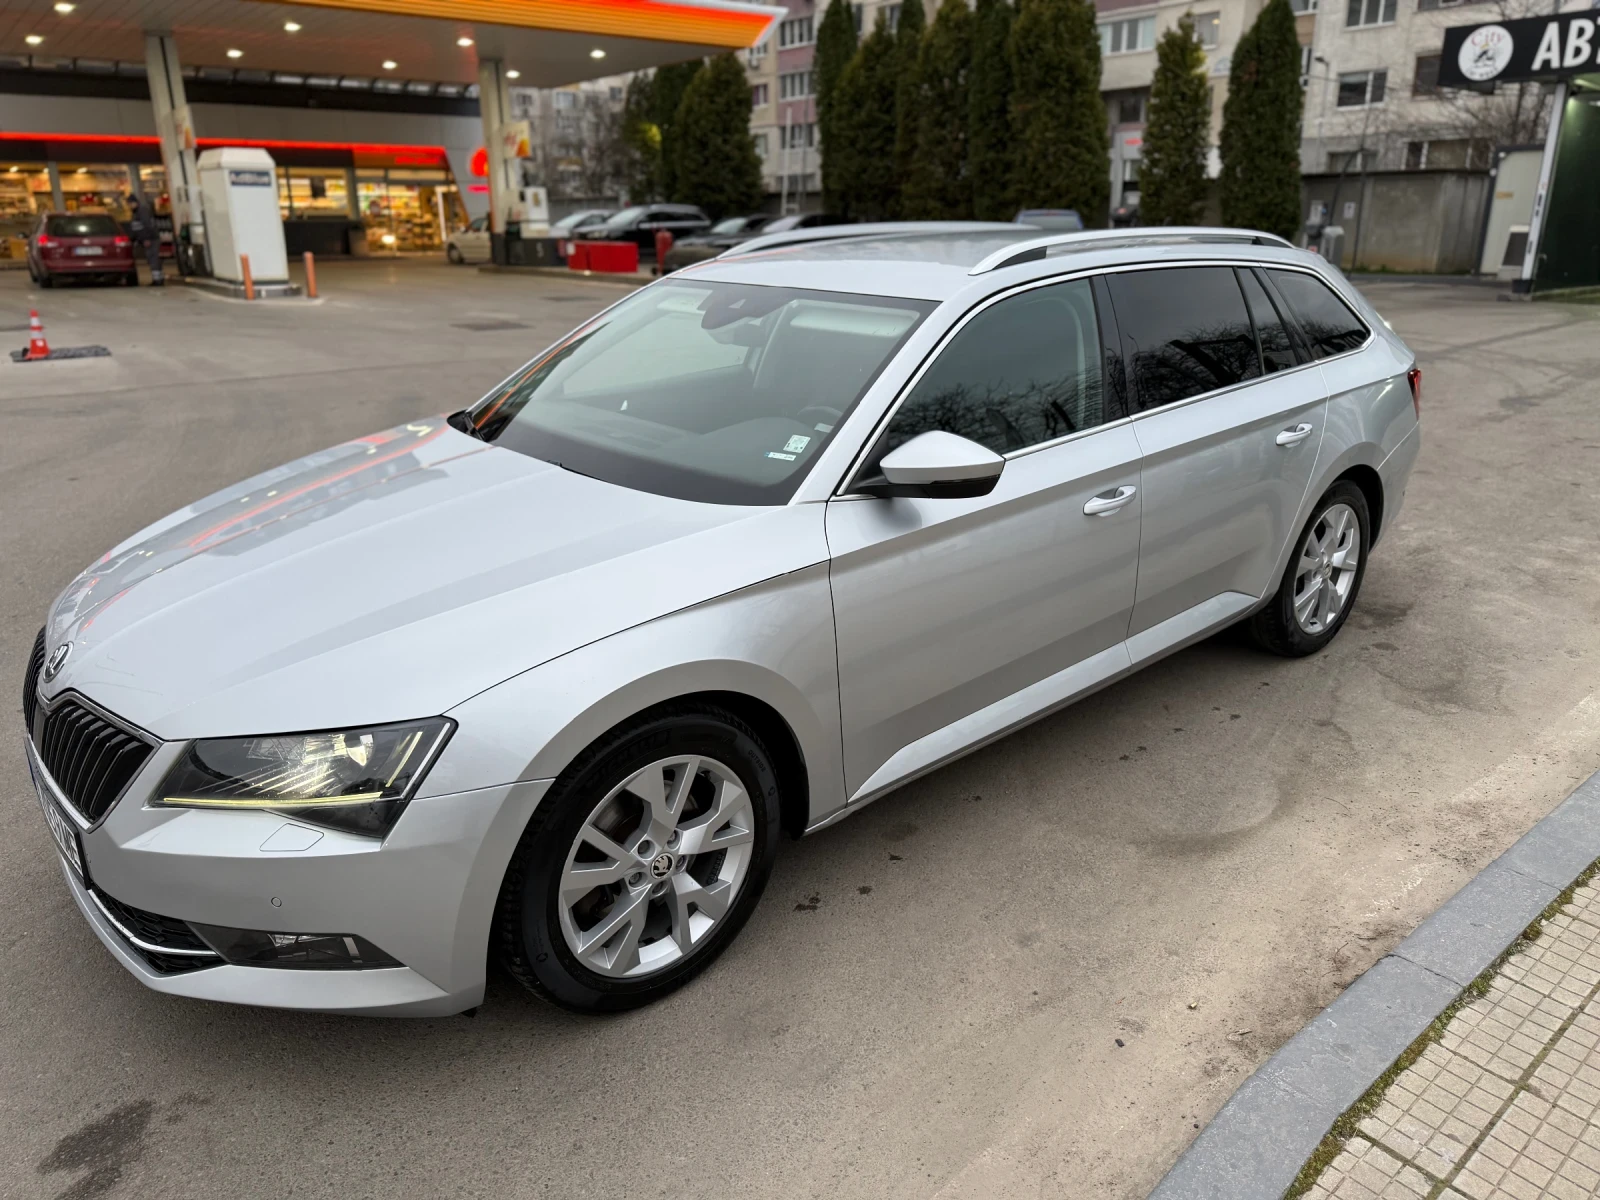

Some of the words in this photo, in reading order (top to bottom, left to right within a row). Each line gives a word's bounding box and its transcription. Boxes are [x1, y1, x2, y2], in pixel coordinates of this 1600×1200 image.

[1471, 30, 1504, 47] City
[1531, 16, 1600, 71] АВ
[748, 750, 768, 773] OUTSIDE
